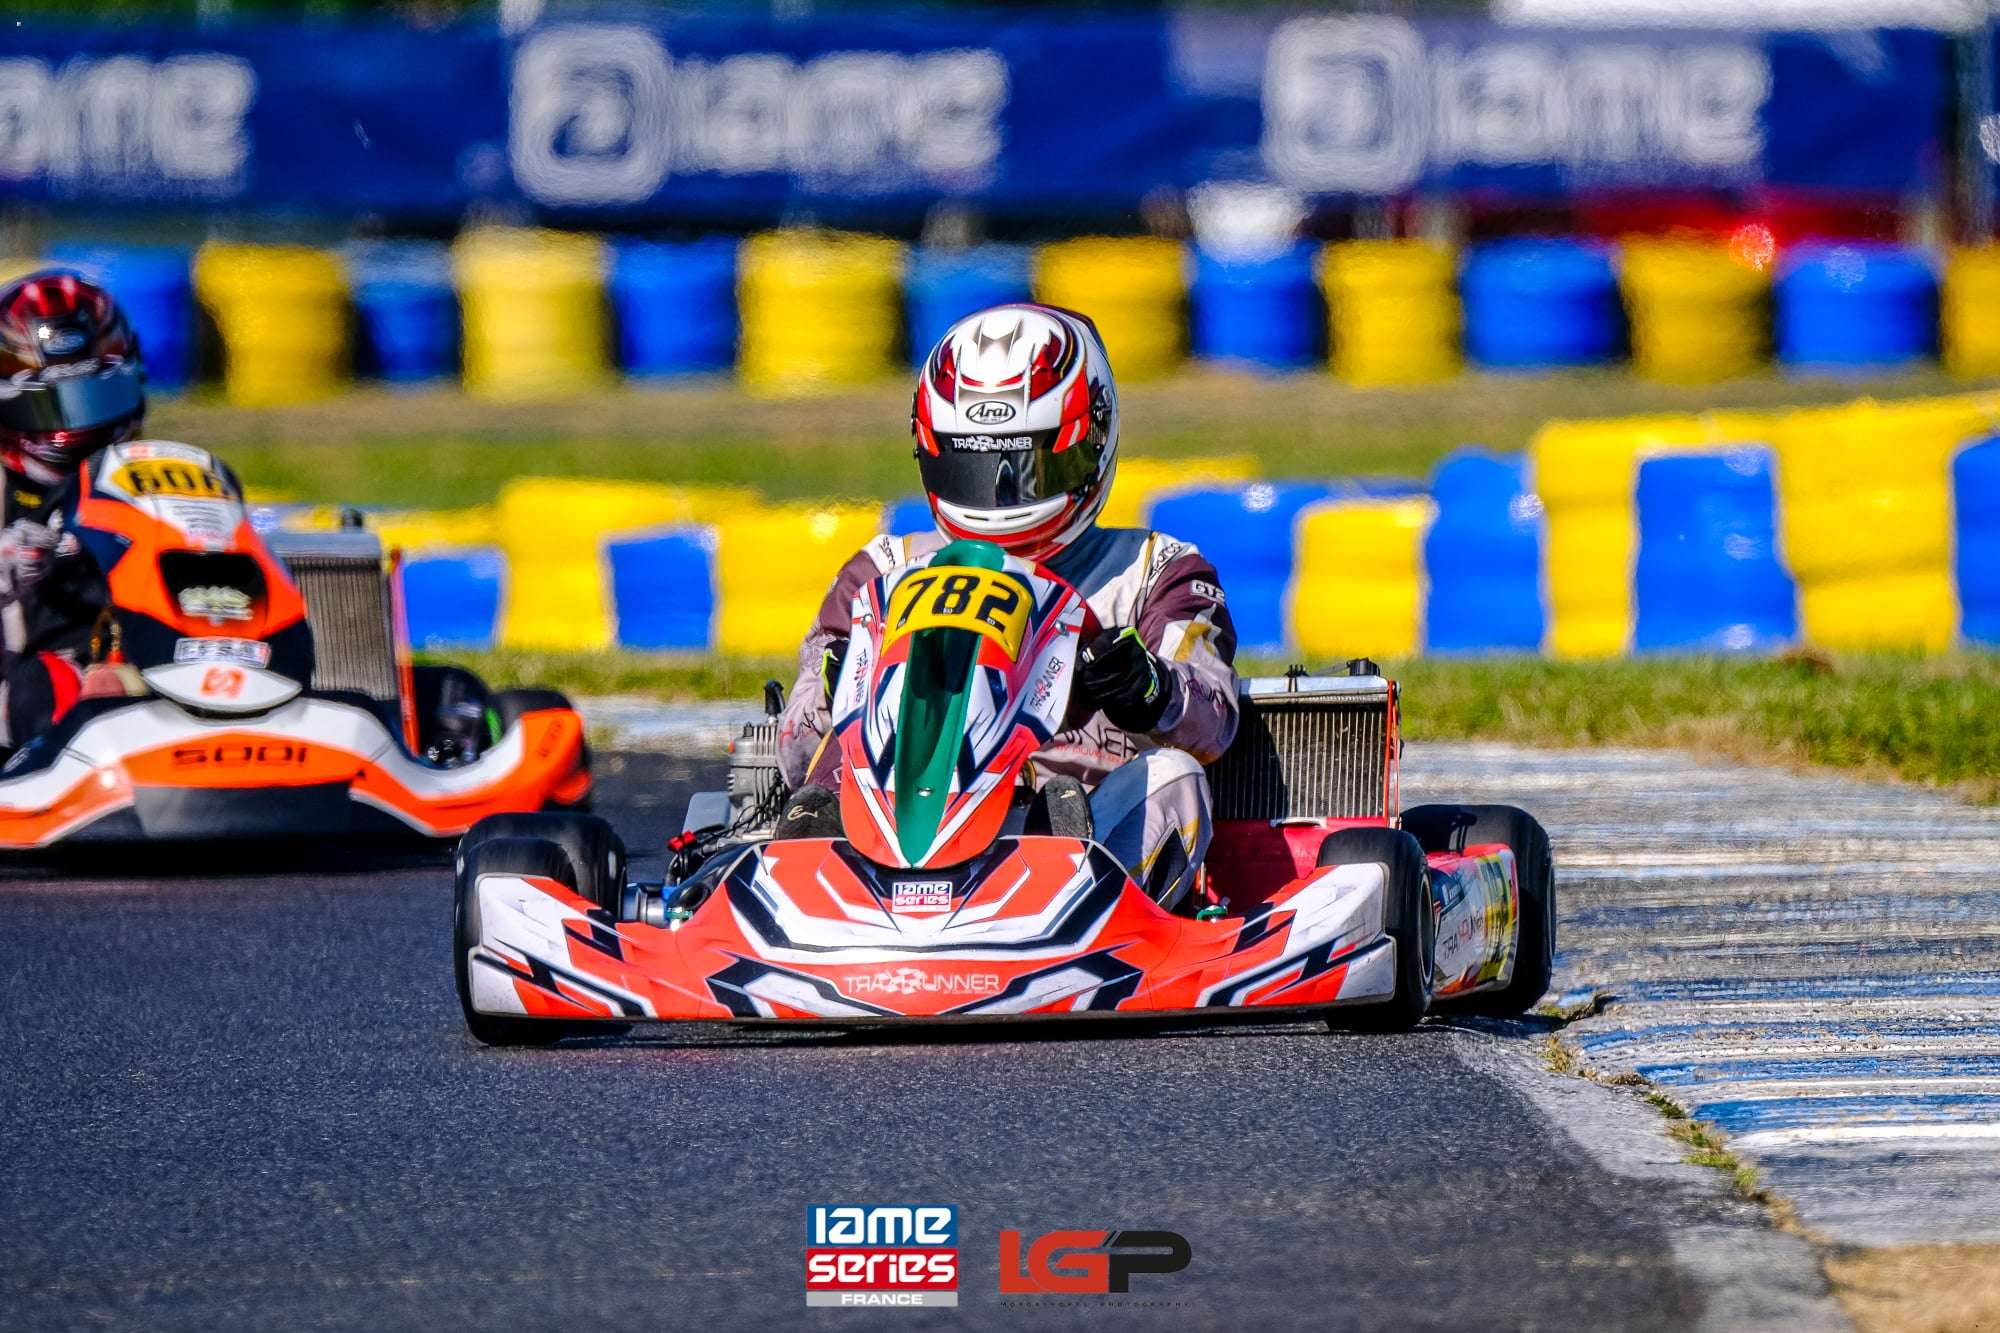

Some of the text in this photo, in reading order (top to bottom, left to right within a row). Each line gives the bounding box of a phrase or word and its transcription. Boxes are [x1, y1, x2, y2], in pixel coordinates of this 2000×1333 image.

[969, 403, 1009, 417] Arai
[896, 575, 1019, 633] 782
[895, 895, 948, 906] series
